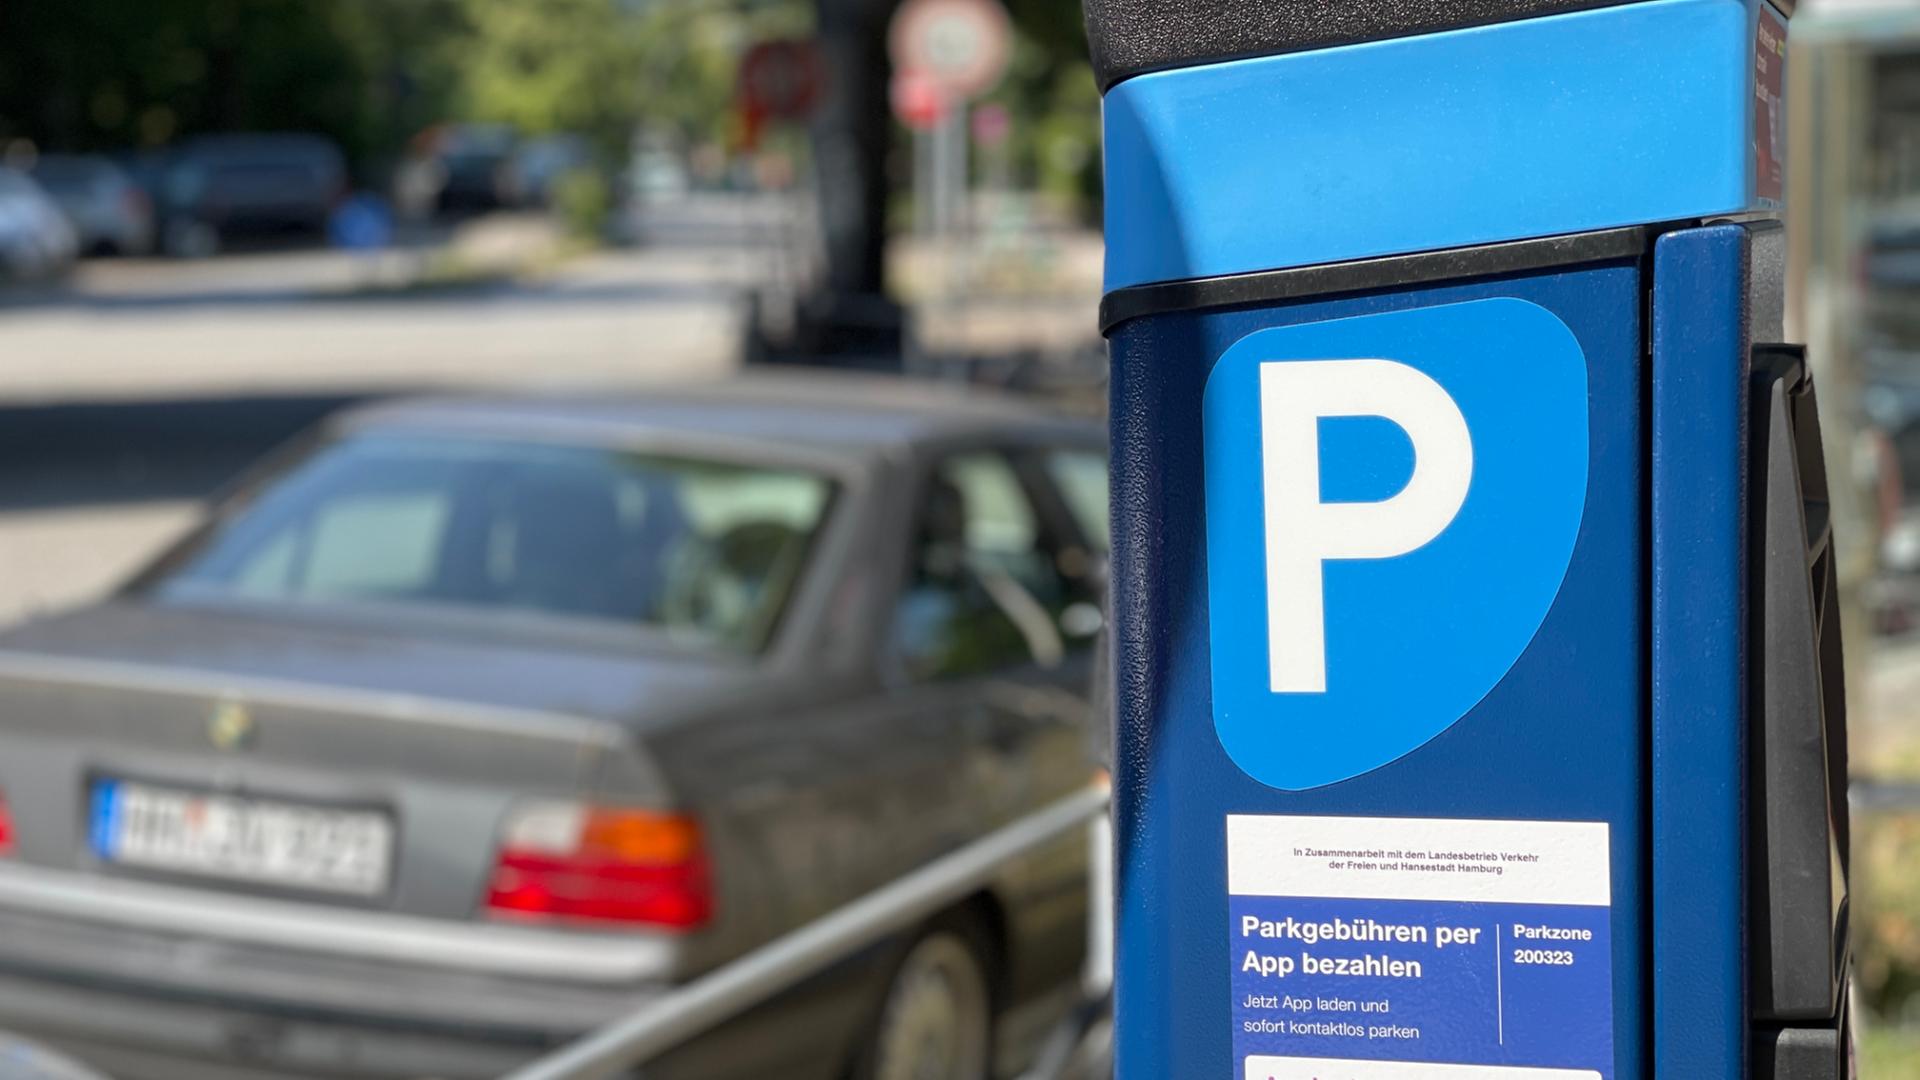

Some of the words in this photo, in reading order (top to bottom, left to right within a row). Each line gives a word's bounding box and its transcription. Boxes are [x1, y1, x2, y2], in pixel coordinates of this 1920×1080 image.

[1260, 358, 1473, 693] P
[1293, 847, 1303, 857] In
[1305, 847, 1385, 859] Zusammenarbeit
[1387, 849, 1403, 859] mit
[1405, 850, 1426, 860] dem
[1428, 850, 1498, 861] Landesbetrieb
[1500, 852, 1539, 863] Verkehr
[1328, 860, 1345, 870] der
[1347, 860, 1377, 870] Freien
[1379, 861, 1398, 871] und
[1401, 862, 1456, 873] Hansestadt
[1458, 863, 1503, 875] Hamburg
[1241, 915, 1428, 944] Parkgebühren
[1436, 925, 1481, 948] per
[1513, 923, 1593, 941] Parkzone
[1242, 950, 1295, 977] App
[1302, 952, 1422, 978] bezahlen
[1513, 948, 1574, 965] 200323
[1242, 994, 1278, 1009] Jetzt
[1282, 995, 1313, 1011] App
[1316, 997, 1357, 1012] laden
[1361, 999, 1389, 1013] und
[1243, 1018, 1286, 1034] sofort
[1289, 1020, 1365, 1037] kontaktlos
[1369, 1024, 1420, 1040] parken
